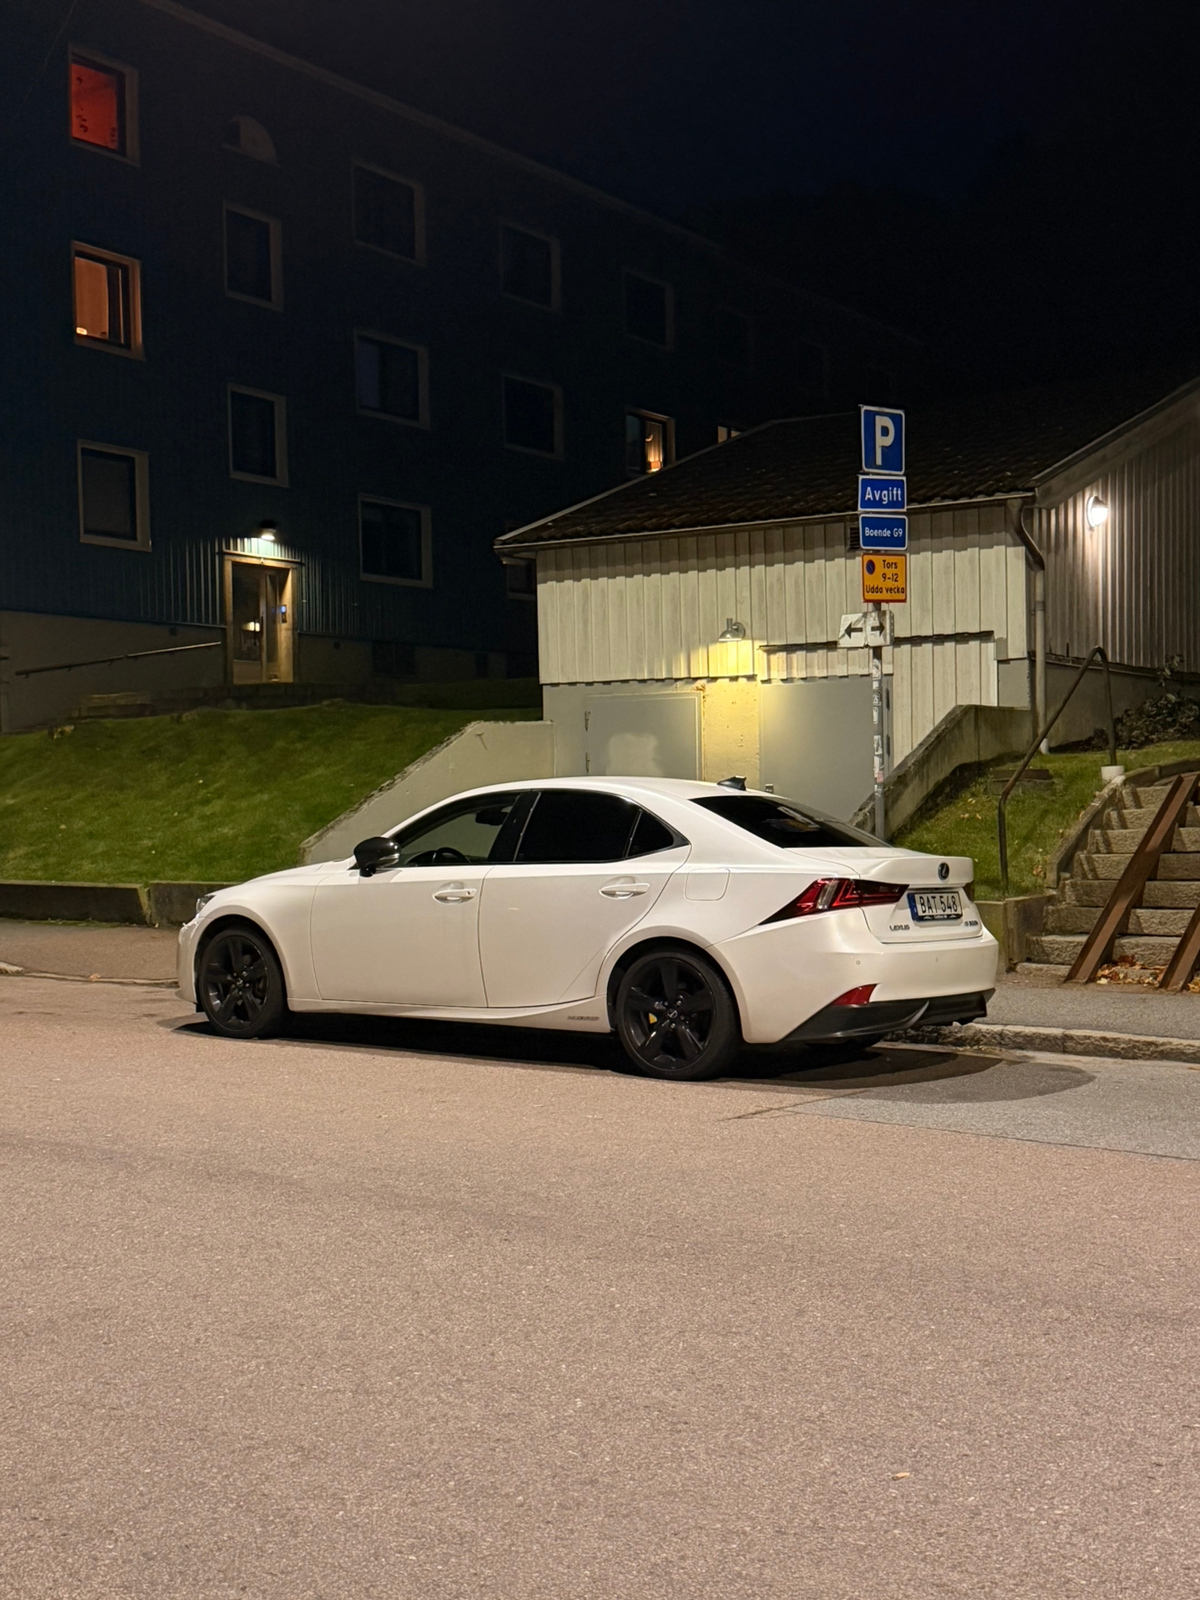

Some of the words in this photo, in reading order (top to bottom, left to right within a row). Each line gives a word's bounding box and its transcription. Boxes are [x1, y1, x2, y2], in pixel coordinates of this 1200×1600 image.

[875, 415, 895, 466] P
[865, 486, 902, 504] Avgift
[865, 527, 891, 537] Boende
[893, 528, 903, 537] G9
[882, 559, 898, 569] Tors
[881, 573, 899, 582] 9-12
[865, 585, 883, 594] Udda
[885, 585, 905, 594] vecka
[919, 896, 938, 913] BAT
[940, 895, 958, 913] 548
